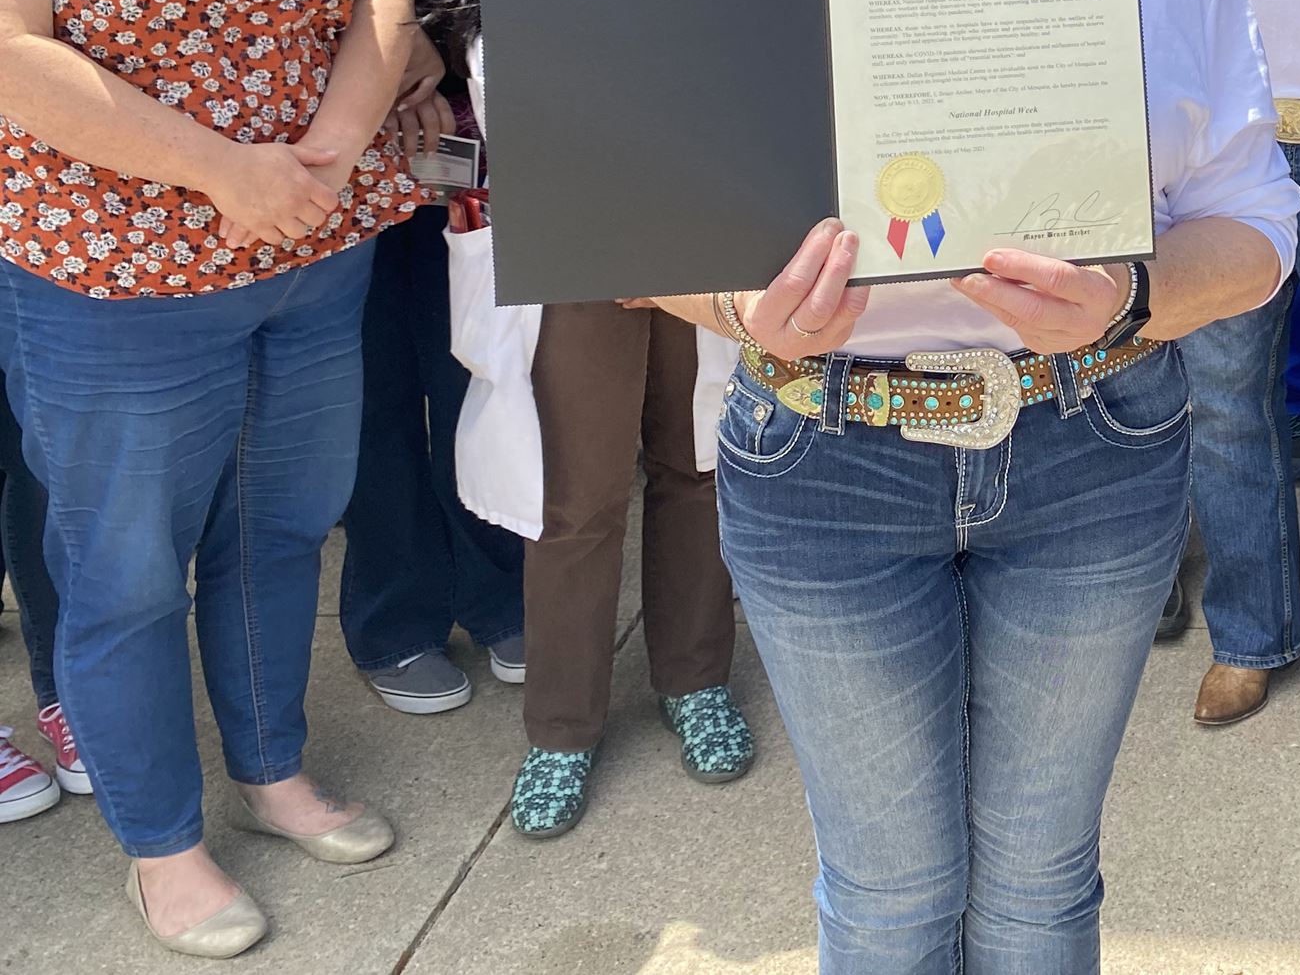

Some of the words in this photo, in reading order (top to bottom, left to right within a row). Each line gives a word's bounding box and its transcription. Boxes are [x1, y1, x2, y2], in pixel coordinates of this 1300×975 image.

[949, 110, 982, 119] National
[983, 108, 1016, 118] Hospital
[1018, 106, 1038, 115] Week
